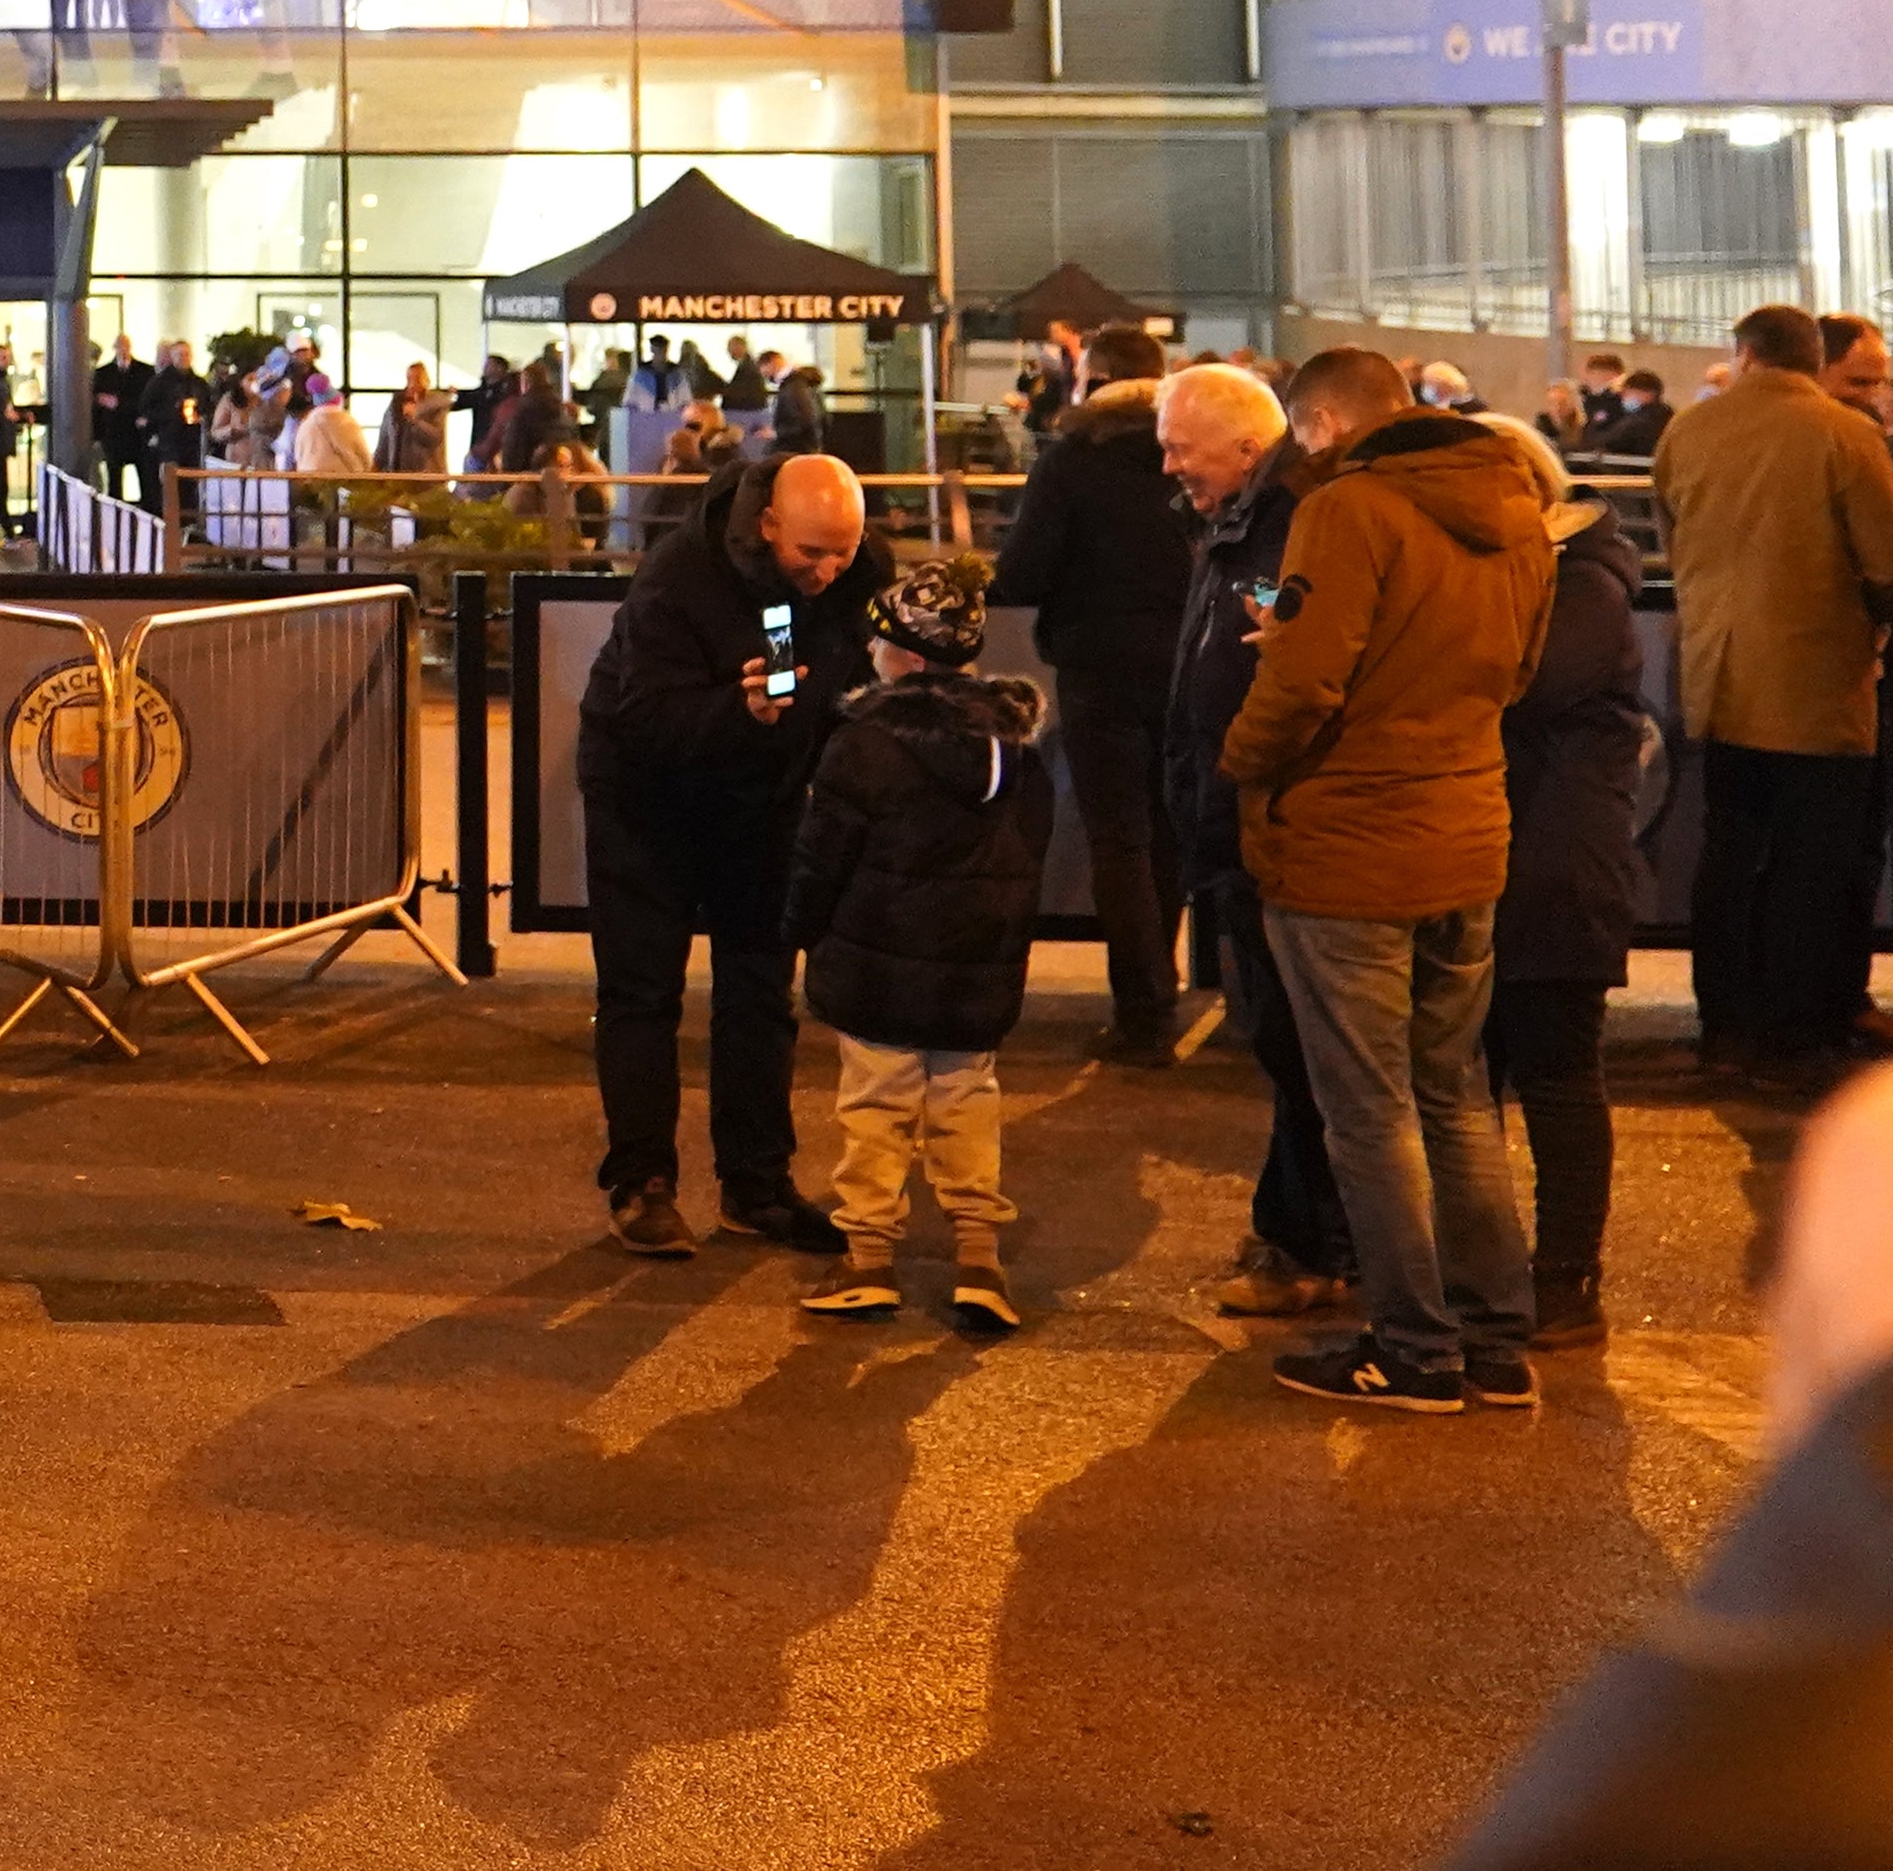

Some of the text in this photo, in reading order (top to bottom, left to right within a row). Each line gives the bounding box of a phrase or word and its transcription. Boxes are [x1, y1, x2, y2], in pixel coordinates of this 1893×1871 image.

[1482, 25, 1531, 57] WE
[1604, 20, 1683, 56] CITY
[638, 293, 906, 321] MANCHESTER CITY
[23, 670, 169, 727] MANCHTER
